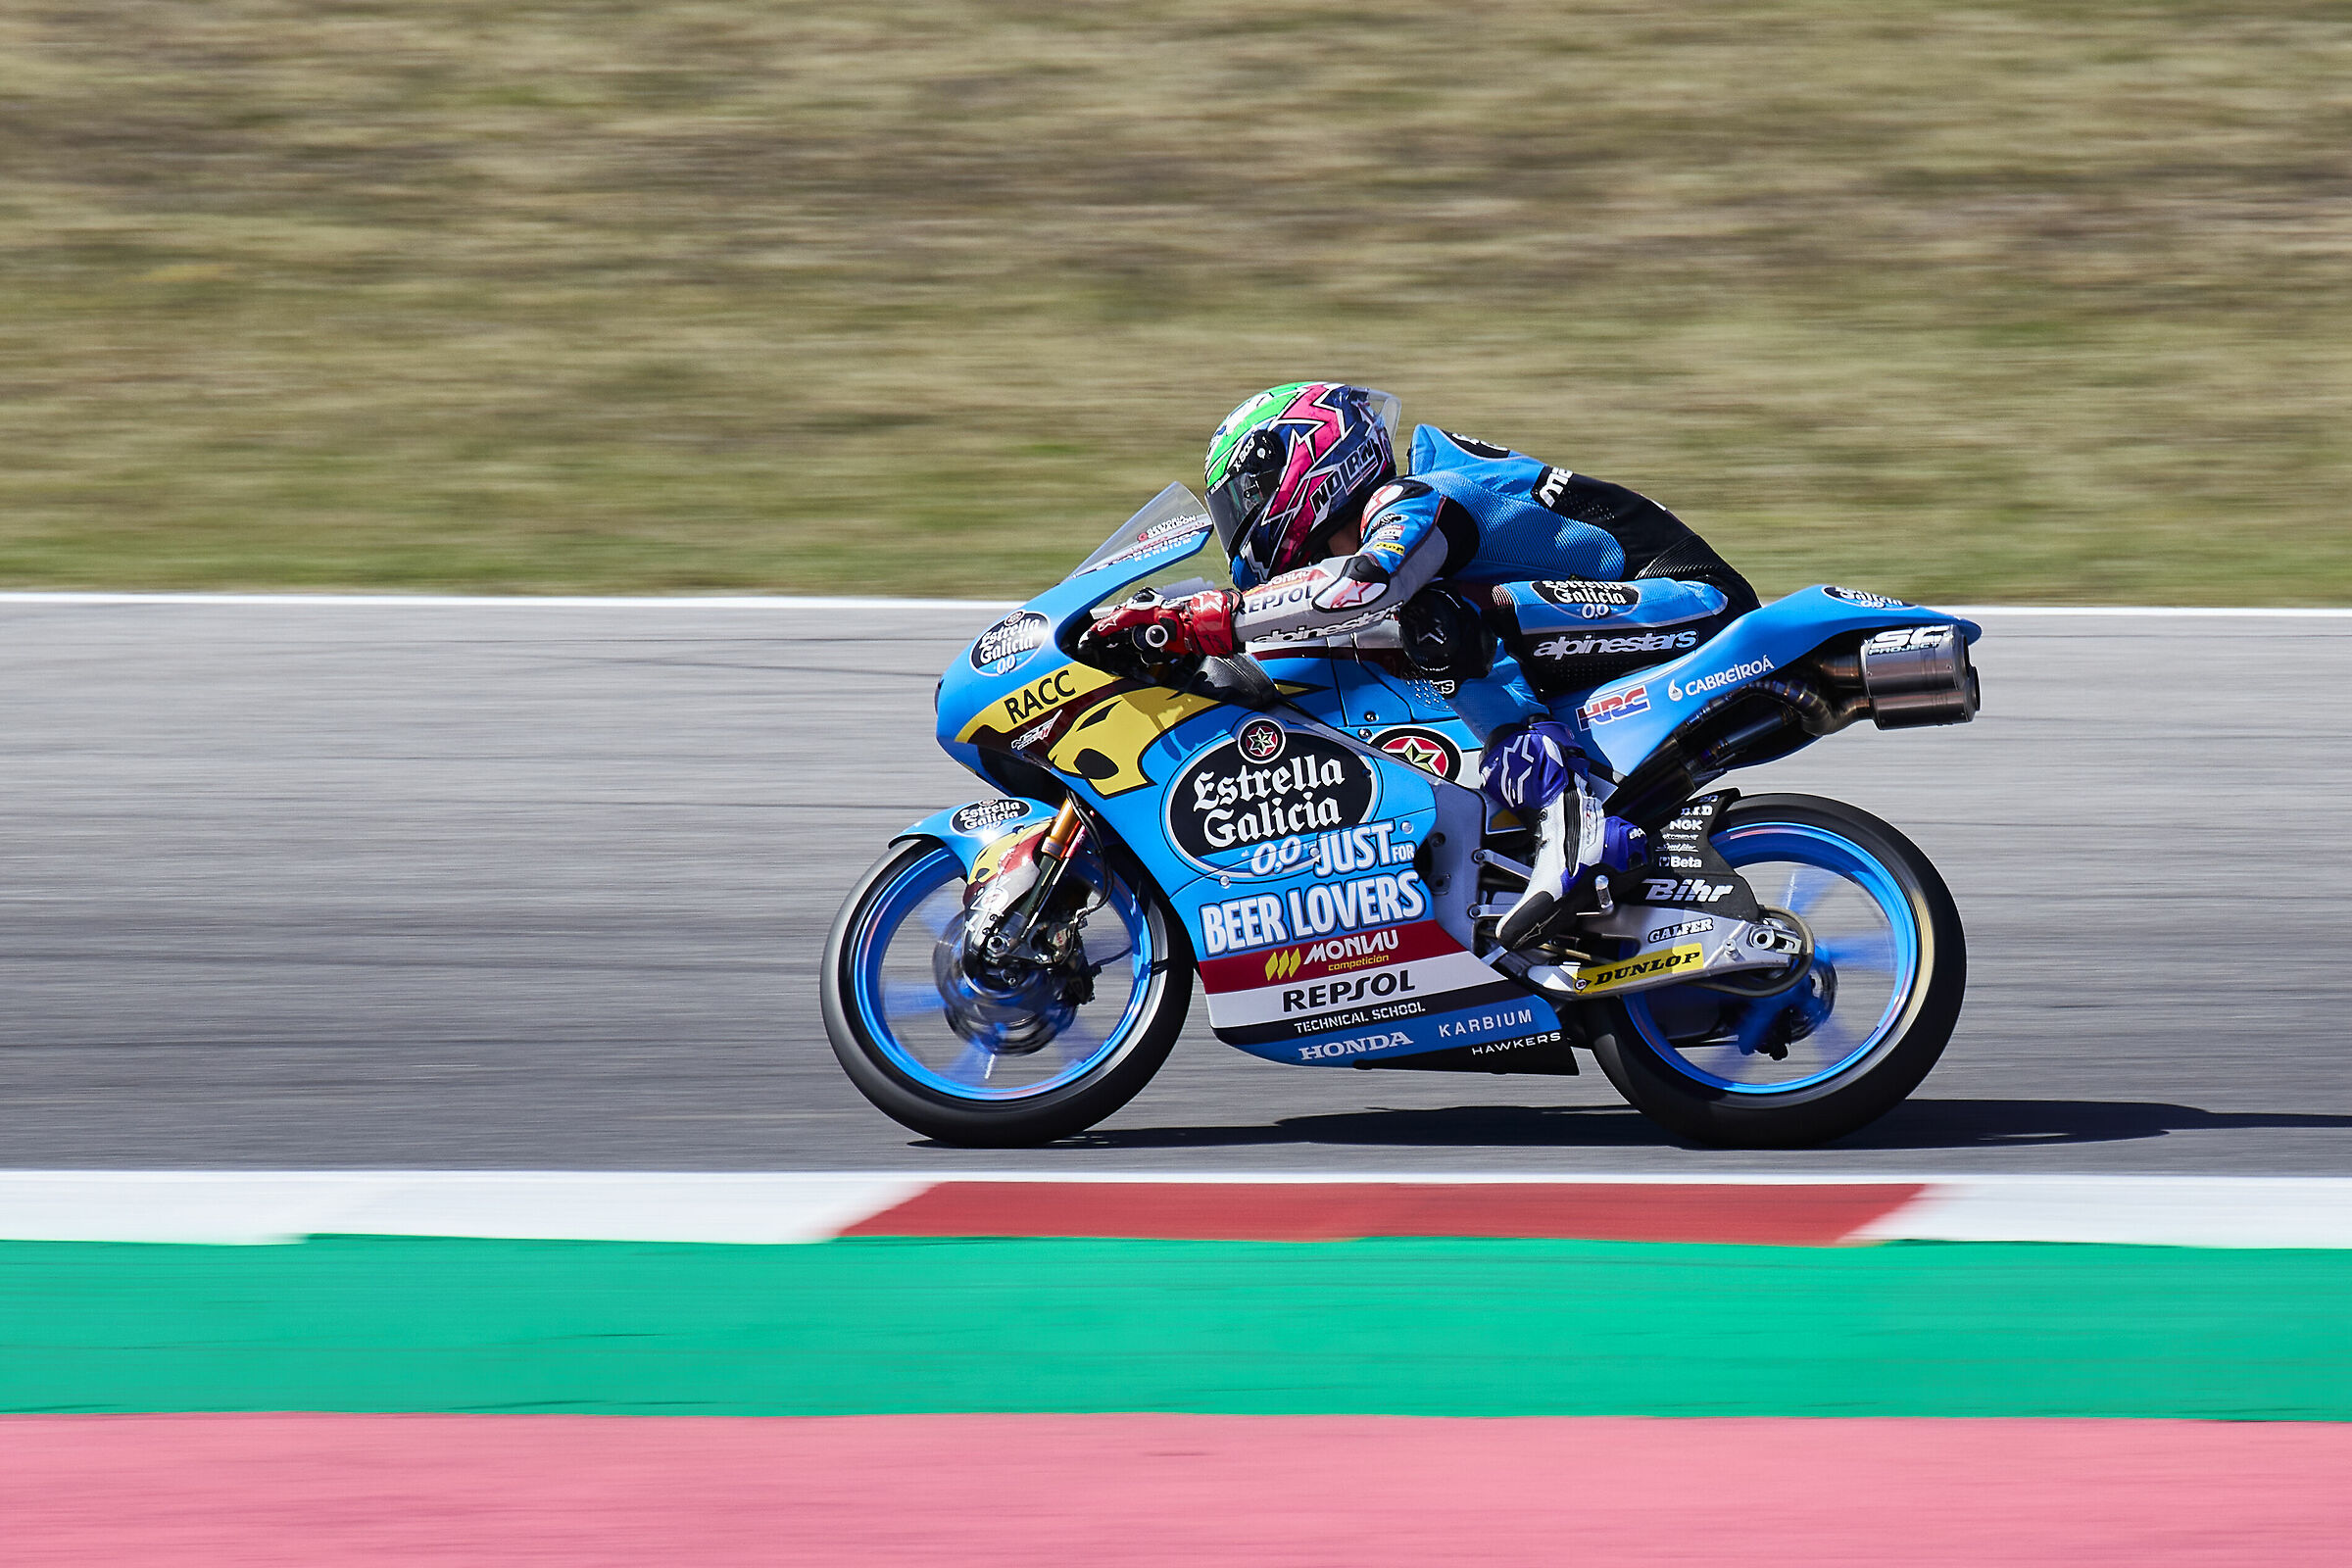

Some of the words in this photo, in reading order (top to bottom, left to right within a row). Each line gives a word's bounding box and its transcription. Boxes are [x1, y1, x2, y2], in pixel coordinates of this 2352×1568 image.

[1554, 587, 1628, 605] Galicia
[979, 618, 1040, 649] Estrella
[980, 633, 1033, 664] Galicia
[1534, 630, 1697, 661] alpinestars
[1685, 655, 1775, 696] CABREIROÁ
[1004, 669, 1076, 724] RACC
[1193, 754, 1346, 812] Estrella
[959, 801, 1021, 822] Estrella
[963, 810, 1019, 830] Galicia
[1203, 791, 1343, 848] Galicia
[1669, 818, 1703, 831] NGK
[1314, 823, 1394, 876] JUST
[1392, 844, 1415, 863] FOR
[1670, 856, 1702, 867] Beta
[1642, 878, 1734, 903] Bihr
[1201, 895, 1288, 956] BEER
[1288, 871, 1426, 938] LOVERS
[1649, 918, 1713, 943] GALFER
[1328, 955, 1390, 972] competición
[1594, 952, 1700, 985] DUNLOP
[1283, 970, 1415, 1012] REPSOL
[1294, 1011, 1369, 1034] TECHNICAL
[1372, 1002, 1426, 1020] SCHOOL
[1439, 1008, 1533, 1038] KARBIUM
[1298, 1031, 1414, 1060] HONDA
[1472, 1032, 1561, 1055] HAWKERS
